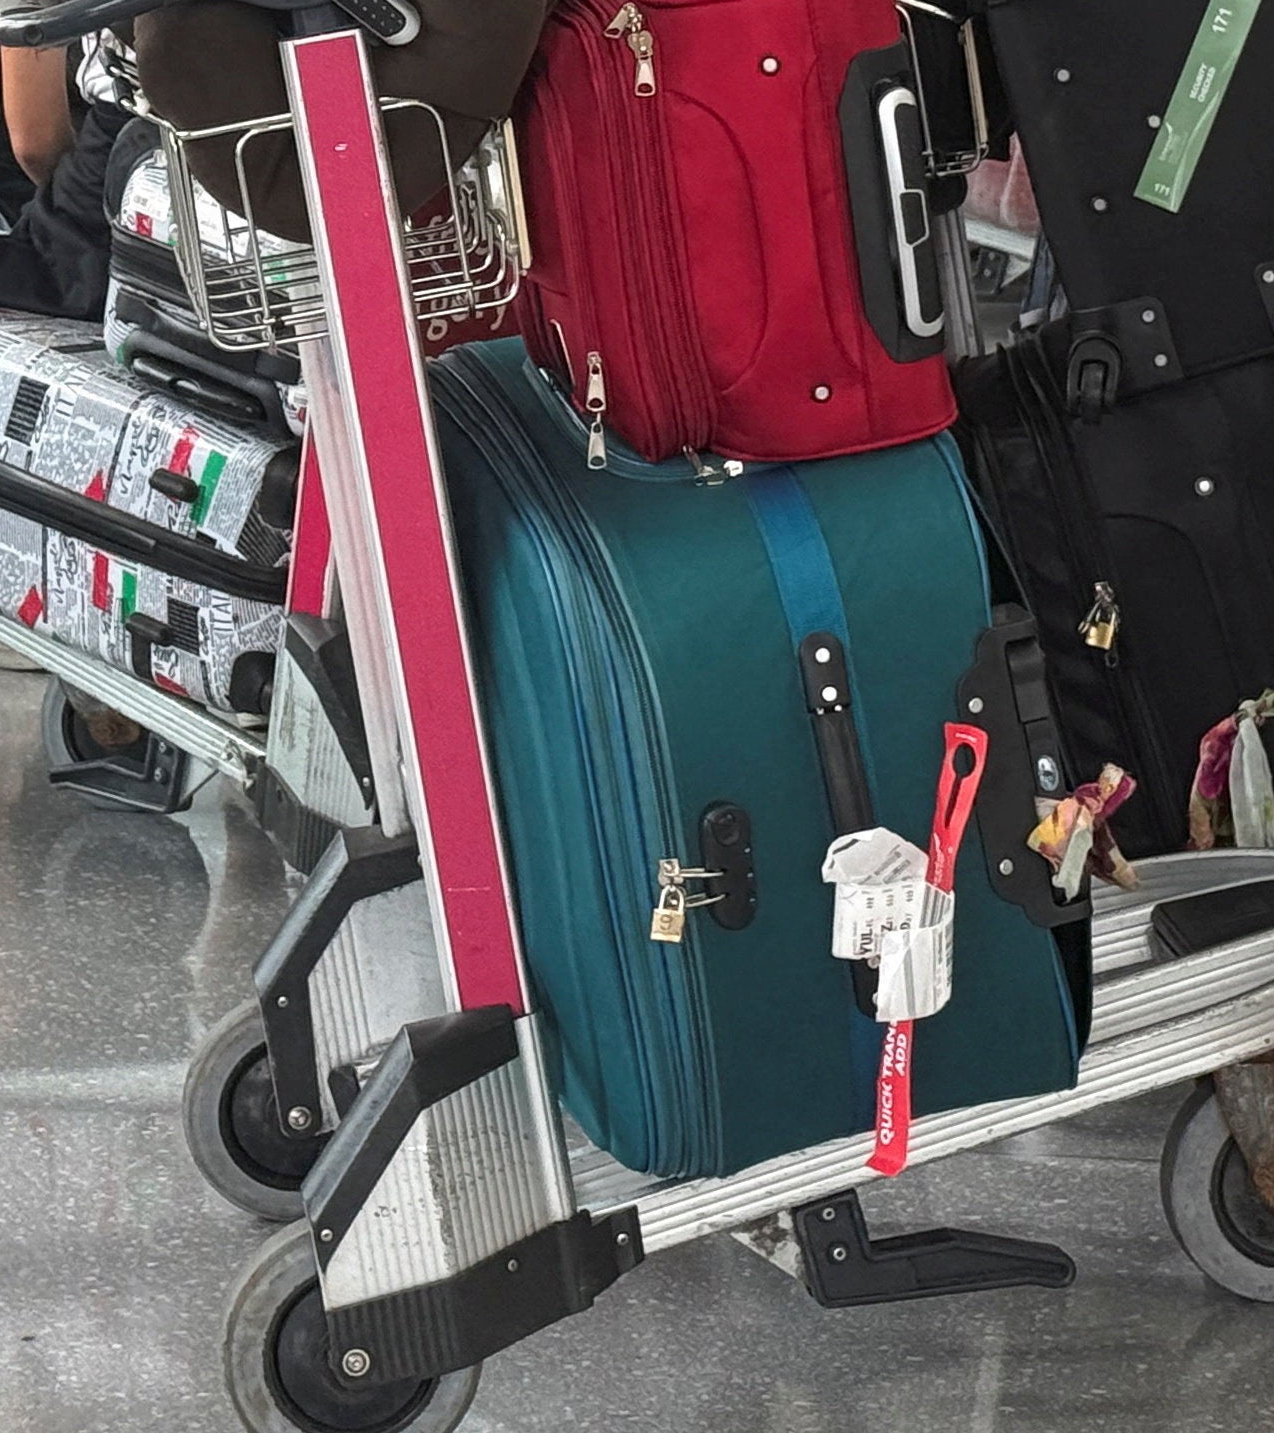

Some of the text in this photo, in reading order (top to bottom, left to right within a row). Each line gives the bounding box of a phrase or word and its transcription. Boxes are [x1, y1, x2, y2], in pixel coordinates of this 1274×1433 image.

[1211, 6, 1233, 34] 171
[1153, 182, 1171, 197] 171
[895, 1033, 908, 1077] ADD
[880, 1081, 896, 1146] QUICK
